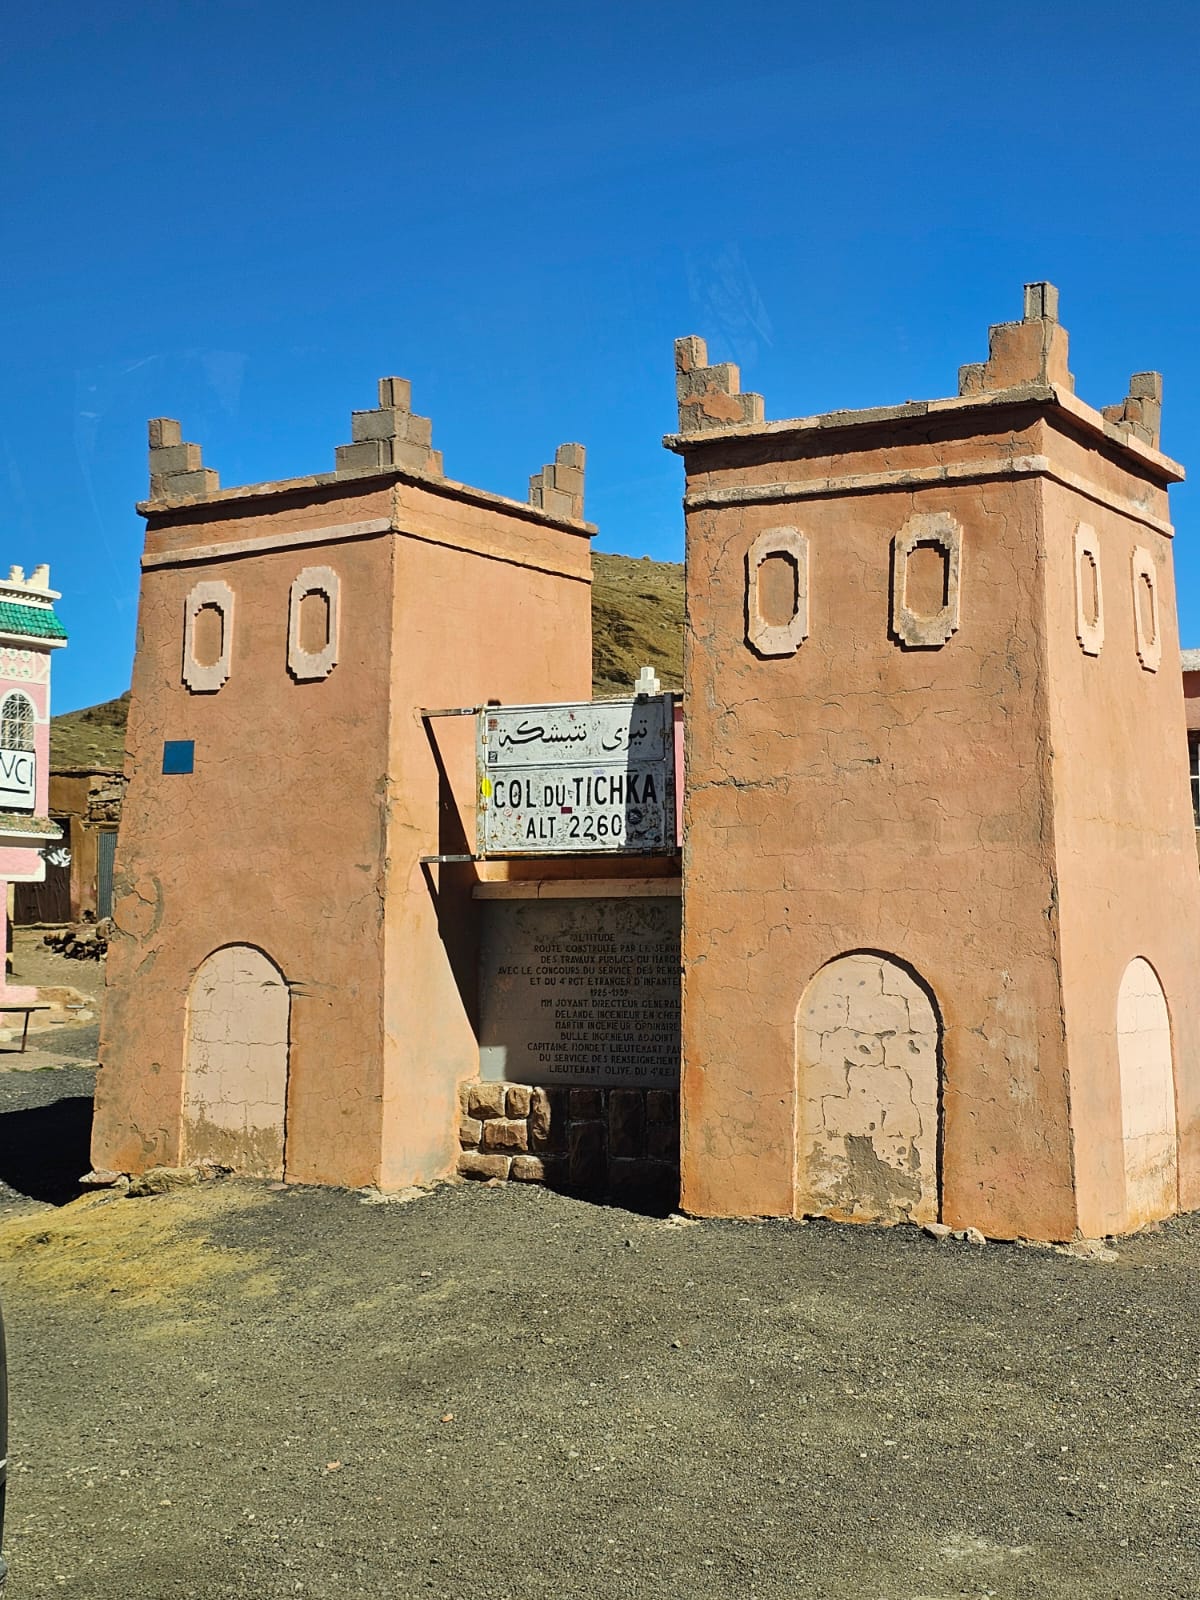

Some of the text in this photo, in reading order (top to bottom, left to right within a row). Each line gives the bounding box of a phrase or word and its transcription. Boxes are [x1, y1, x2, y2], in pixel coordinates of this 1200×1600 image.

[493, 774, 657, 809] COL DU TICHKA
[526, 816, 556, 839] ALT
[569, 814, 622, 838] 2260
[534, 944, 562, 953] ROUTE
[565, 944, 617, 953] CONSTRUITE
[620, 944, 636, 953] PAR
[540, 955, 557, 964] DES
[561, 955, 595, 964] TRAVAUX
[598, 955, 634, 964] PUBLICS
[637, 955, 649, 963] DU
[497, 966, 519, 975] AVEC
[521, 966, 532, 975] LE
[535, 966, 580, 975] CONCOURS
[583, 966, 595, 975] DU
[598, 966, 632, 975] SERVICE
[637, 966, 653, 975] DES
[530, 977, 541, 986] ET
[544, 977, 556, 986] DU
[568, 977, 584, 986] RGT
[555, 999, 589, 1008] JOYANT
[591, 999, 638, 1008] DIRECTEUR
[555, 1010, 681, 1020] DELANDE INGENIEUR EN CHEF
[555, 1021, 679, 1032] MARTIN INGENIEUR ORDINAIRE
[560, 1032, 673, 1042] BULLE INGENIEUR ADJOINT
[527, 1042, 568, 1051] CAPITAINE
[610, 1043, 663, 1054] LIEUTENANT
[539, 1053, 551, 1062] DU
[554, 1053, 588, 1062] SERVICE
[591, 1054, 608, 1063] DES
[549, 1065, 600, 1074] LIEUTENANT
[605, 1065, 630, 1075] OLIVE
[635, 1066, 647, 1076] DU
